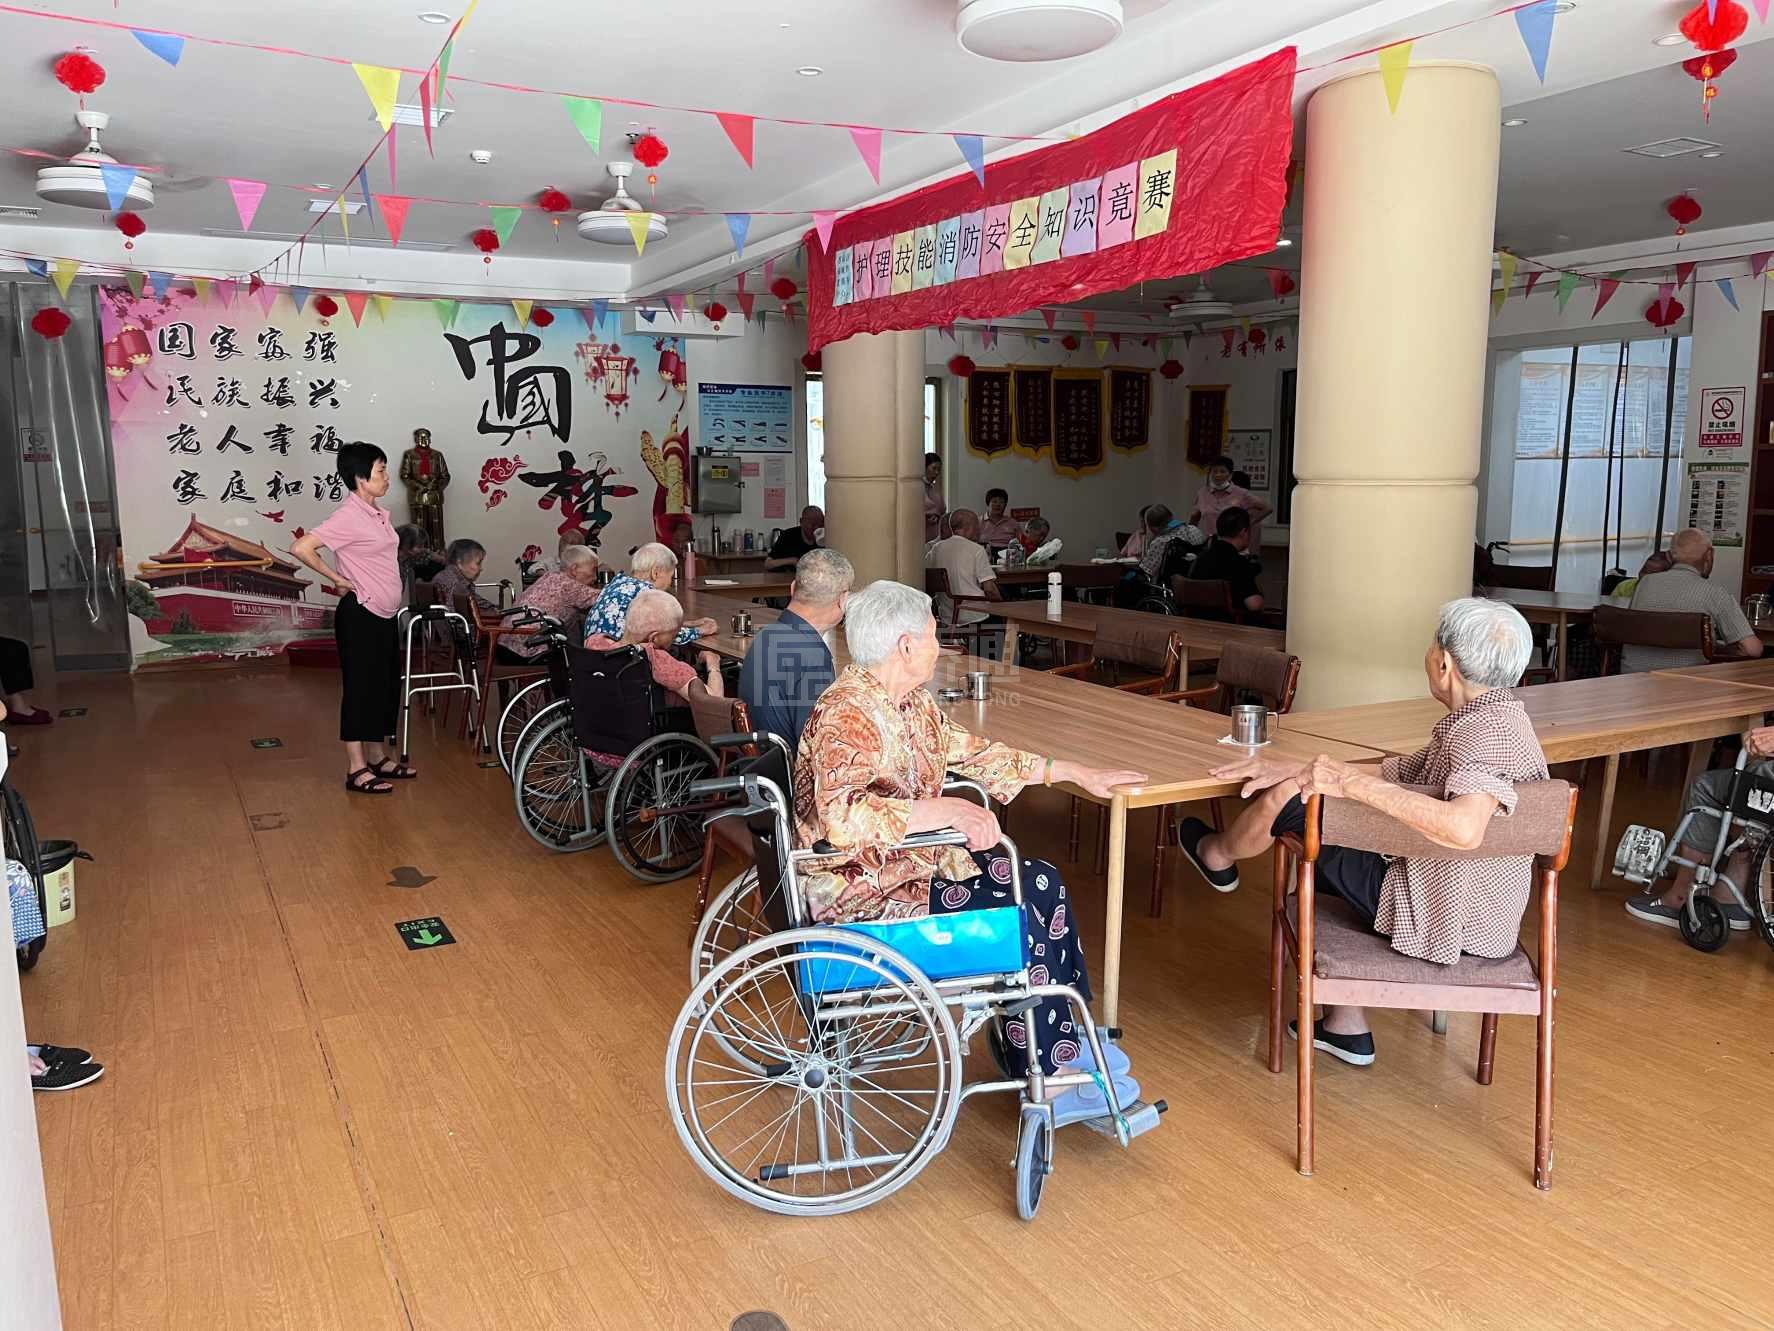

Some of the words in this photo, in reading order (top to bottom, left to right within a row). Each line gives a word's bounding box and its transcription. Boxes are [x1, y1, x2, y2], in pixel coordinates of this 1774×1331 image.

[158, 322, 339, 362] 国家富强
[167, 375, 341, 408] 民族振兴
[167, 423, 345, 456] 老人幸福
[172, 470, 344, 504] 家庭和谐
